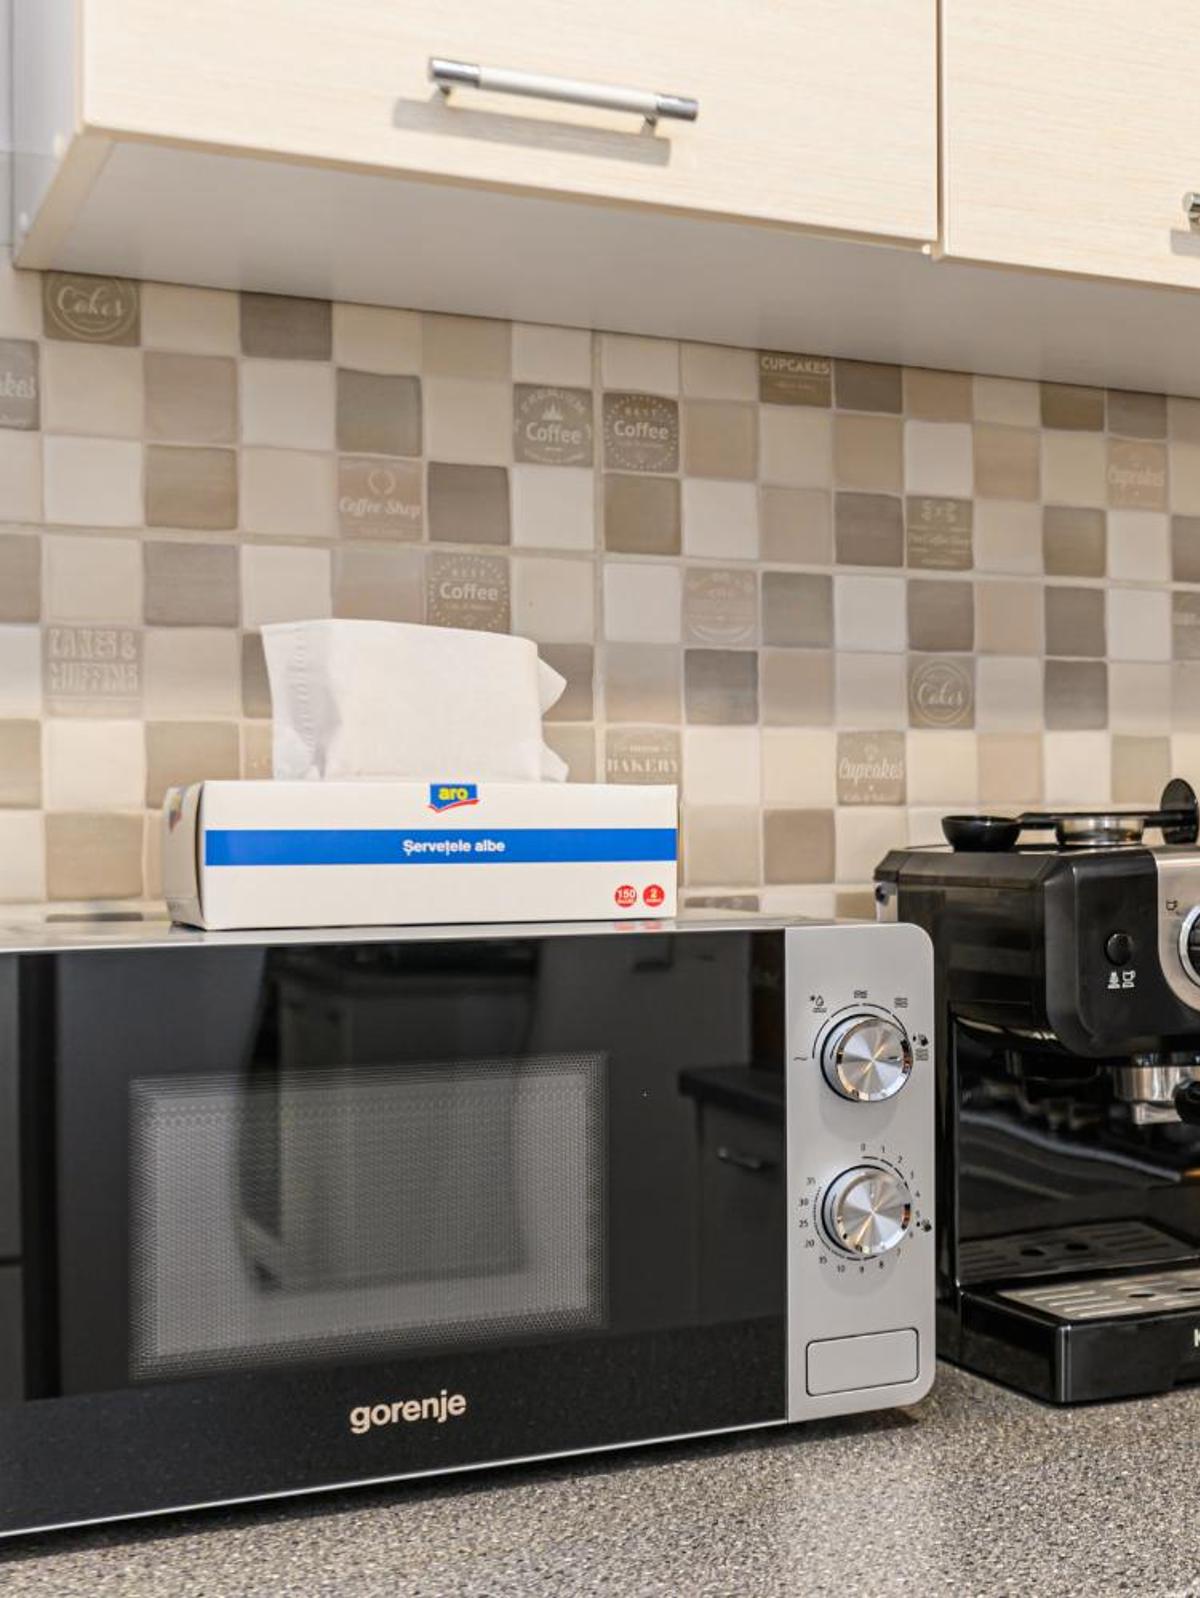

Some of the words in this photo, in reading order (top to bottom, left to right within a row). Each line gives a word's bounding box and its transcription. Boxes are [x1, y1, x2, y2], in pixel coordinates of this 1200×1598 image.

[760, 355, 830, 375] CUPCAKES
[526, 422, 582, 444] Coffee
[613, 420, 669, 440] Coffee
[439, 582, 499, 601] Coffee
[438, 787, 469, 801] aro
[475, 839, 506, 853] albe
[617, 888, 636, 899] 150
[650, 888, 657, 898] 2
[350, 1389, 467, 1434] gorenje
